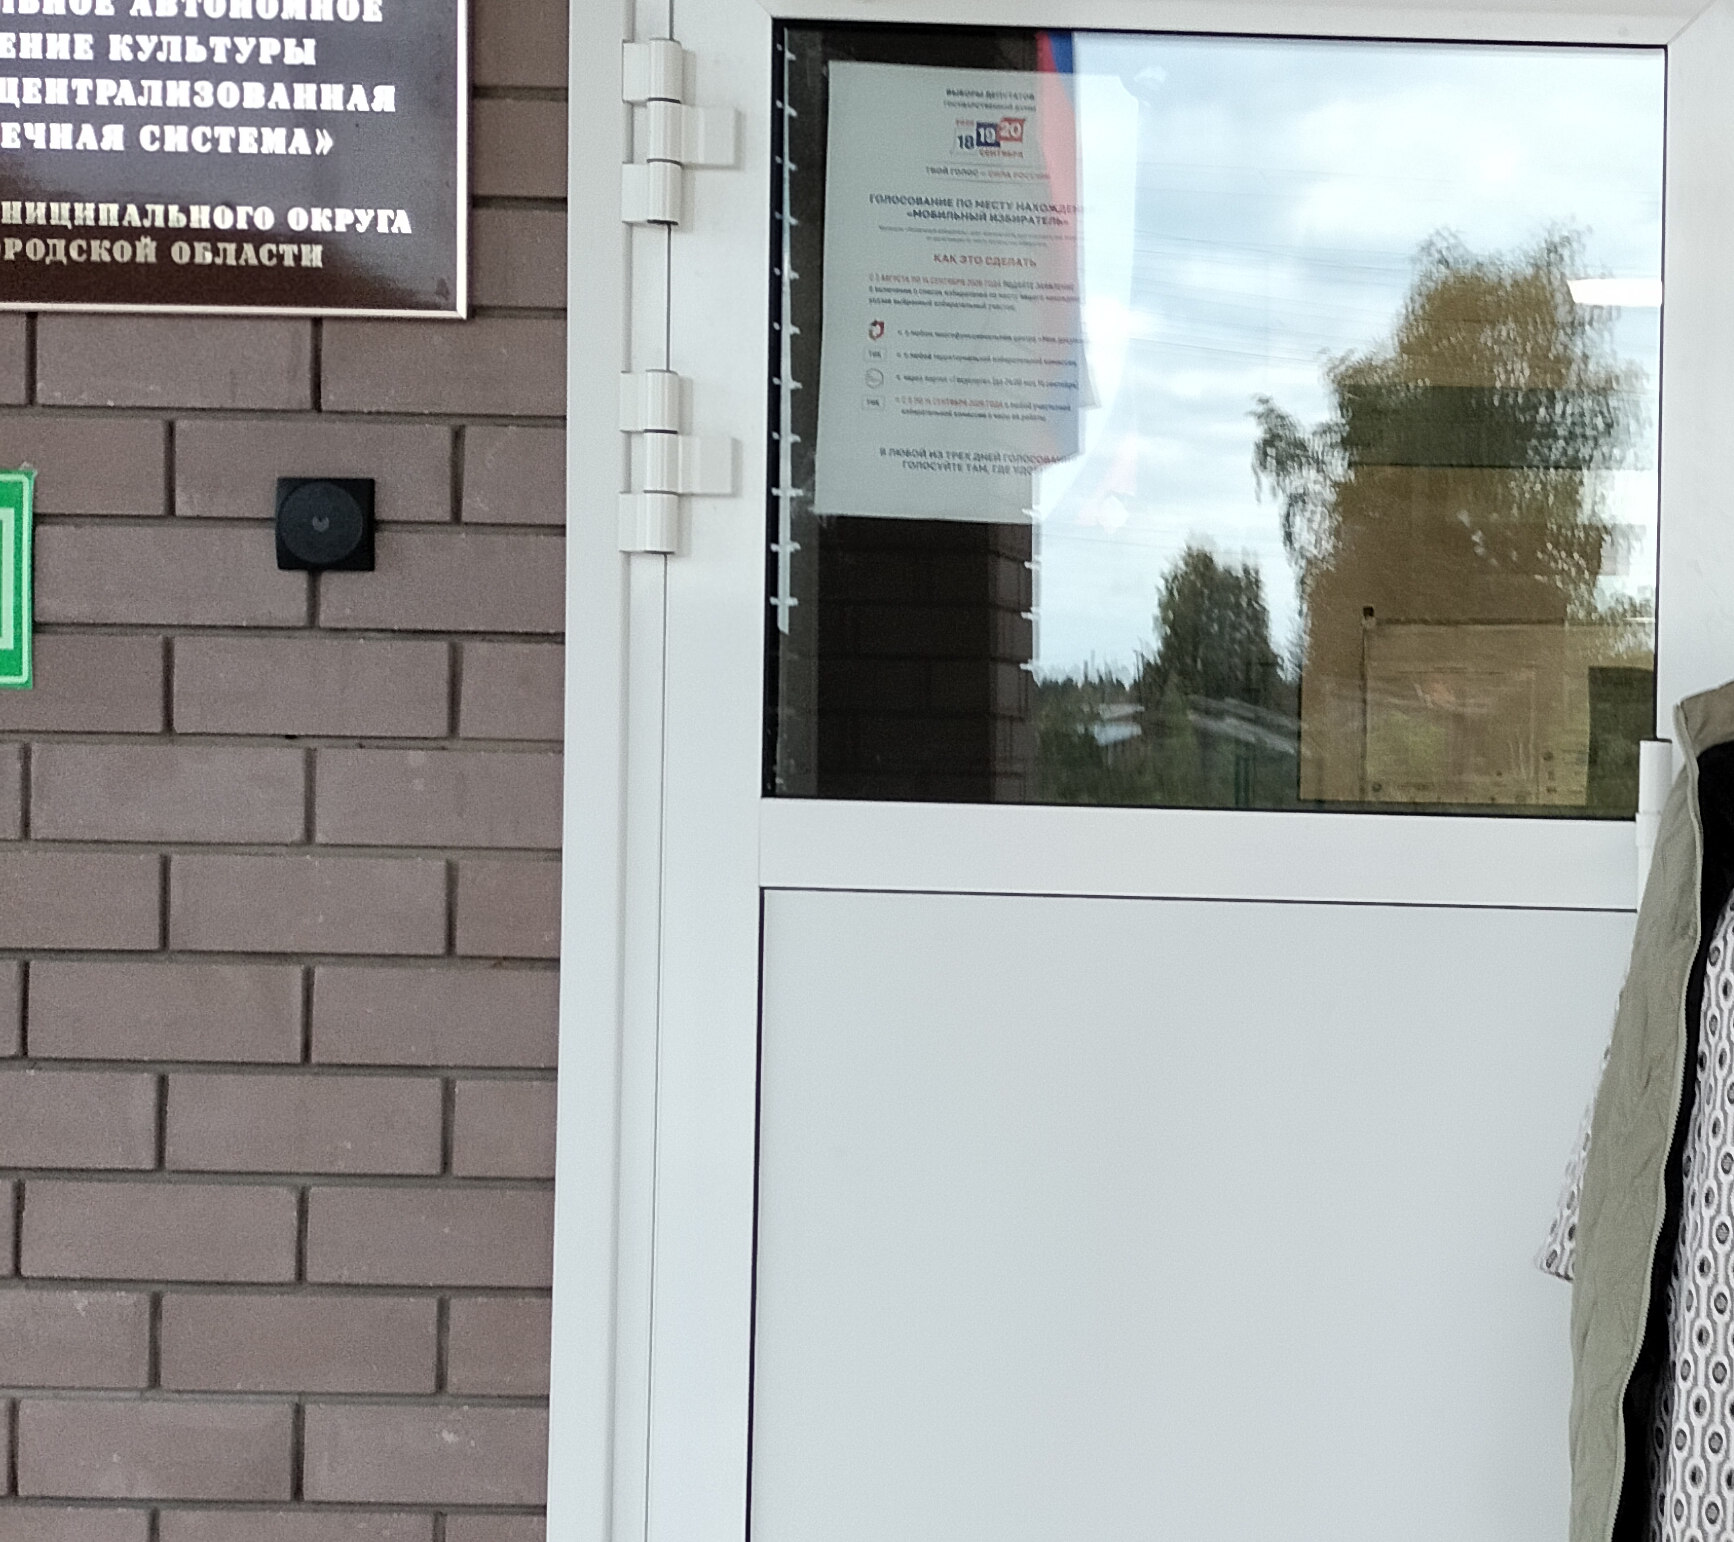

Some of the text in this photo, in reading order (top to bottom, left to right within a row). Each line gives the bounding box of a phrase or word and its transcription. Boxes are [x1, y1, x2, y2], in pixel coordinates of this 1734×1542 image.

[108, 33, 317, 66] КУЛЬТУРЫ
[138, 124, 335, 155] СИСТЕМА»
[999, 121, 1022, 138] 20
[2, 200, 413, 234] НИЦИПАЛЬНОГО ОКРУГА
[0, 235, 324, 268] РОДСКОЙ ОБЛАСТИ
